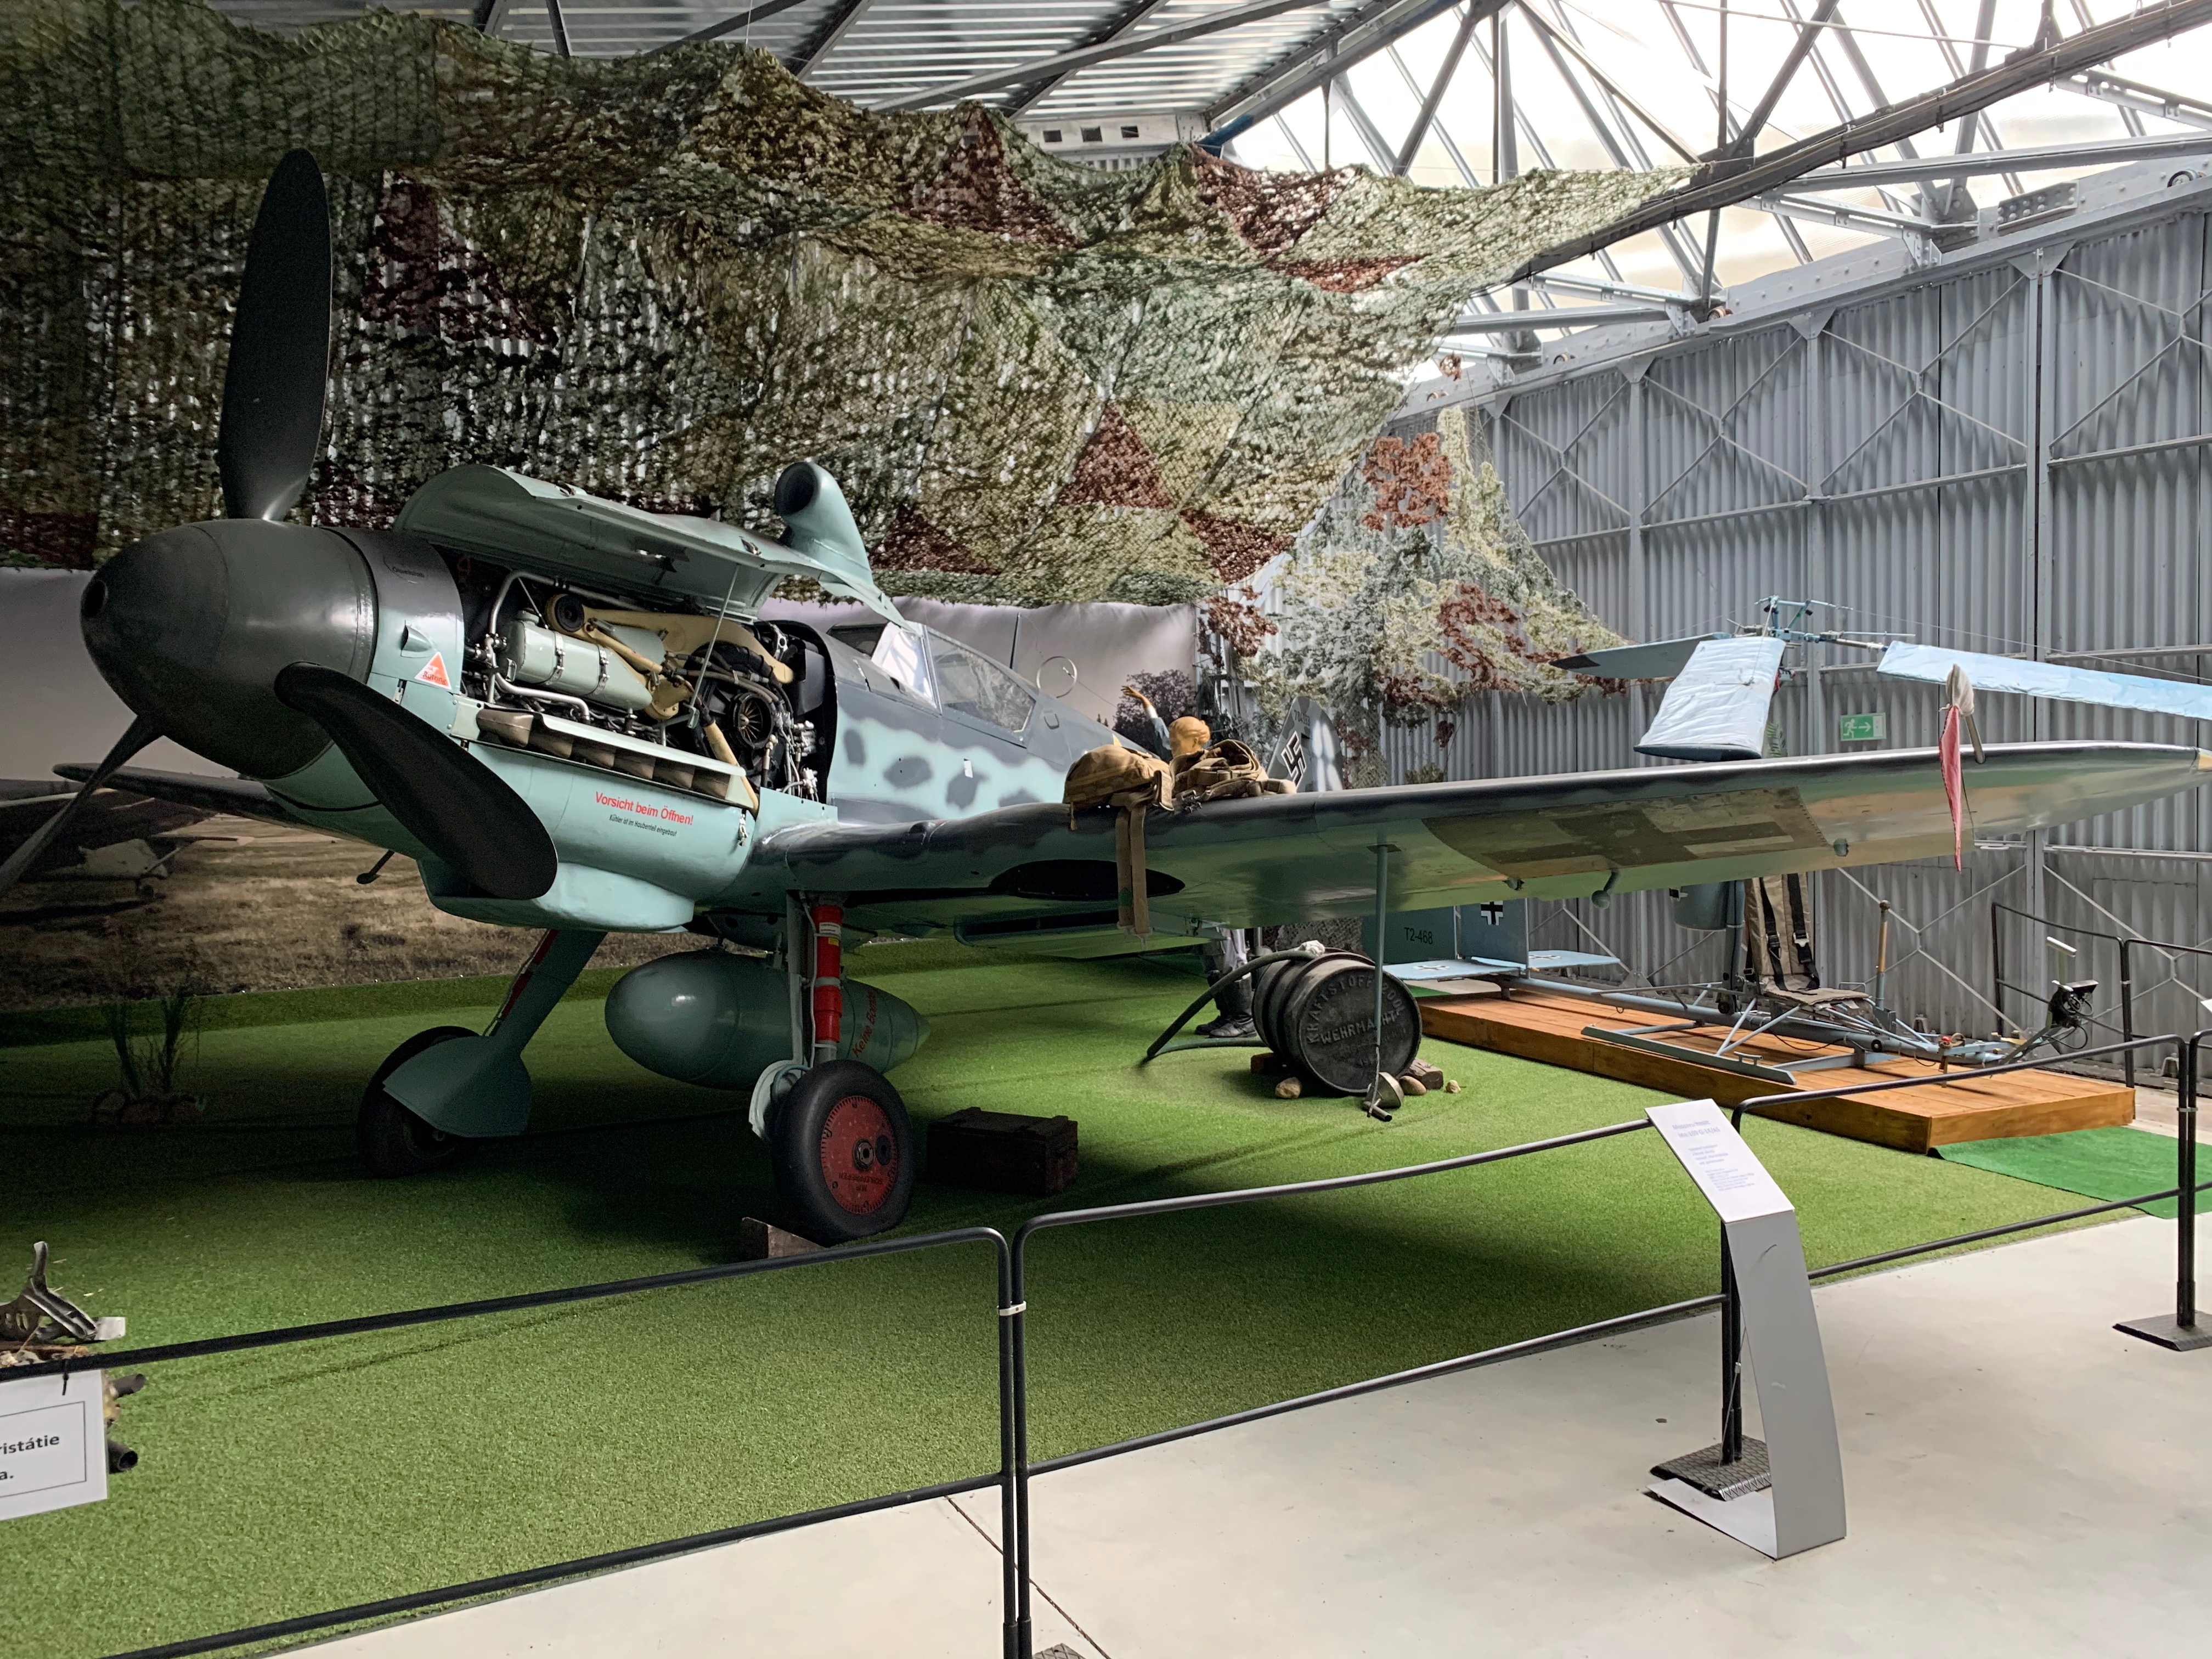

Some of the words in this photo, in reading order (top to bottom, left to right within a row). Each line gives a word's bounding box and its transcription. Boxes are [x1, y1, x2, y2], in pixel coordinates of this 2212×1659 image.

[596, 791, 634, 811] Vorsicht
[635, 802, 658, 817] beim
[661, 805, 693, 826] Öffnen!
[609, 814, 623, 823] Kühler
[634, 820, 657, 832] Haubenteil
[657, 826, 678, 837] eingebaut
[1404, 927, 1433, 945] T2-468
[1306, 974, 1375, 1043] KRAFTSTOFF
[1320, 1010, 1396, 1045] WEHRMAHT
